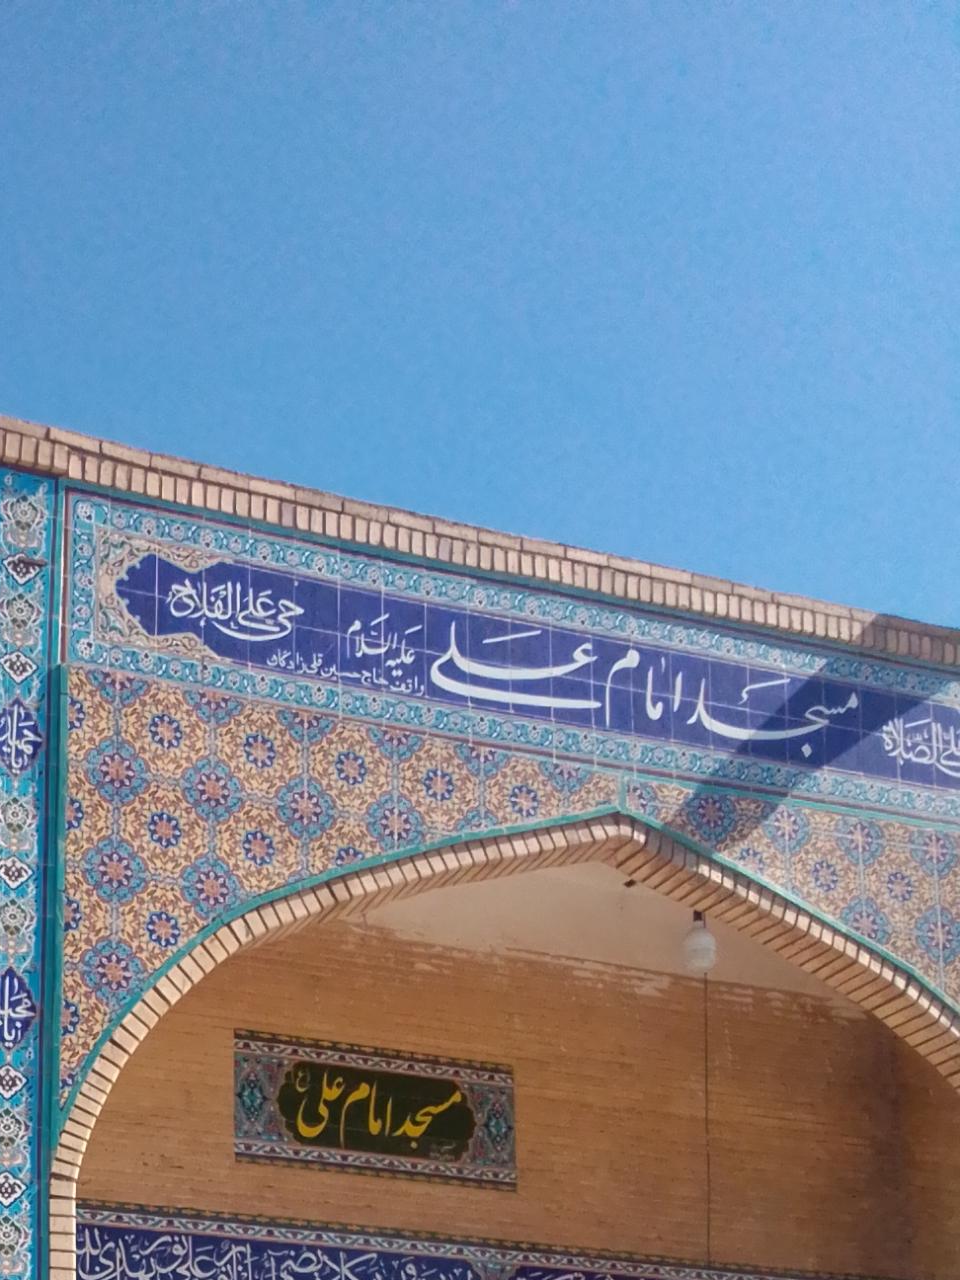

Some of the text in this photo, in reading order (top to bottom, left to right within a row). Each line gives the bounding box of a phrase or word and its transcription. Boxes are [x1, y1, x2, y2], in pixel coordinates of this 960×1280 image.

[296, 1071, 346, 1138] علی
[340, 1080, 393, 1151] امام
[393, 1089, 463, 1151] مسجد
